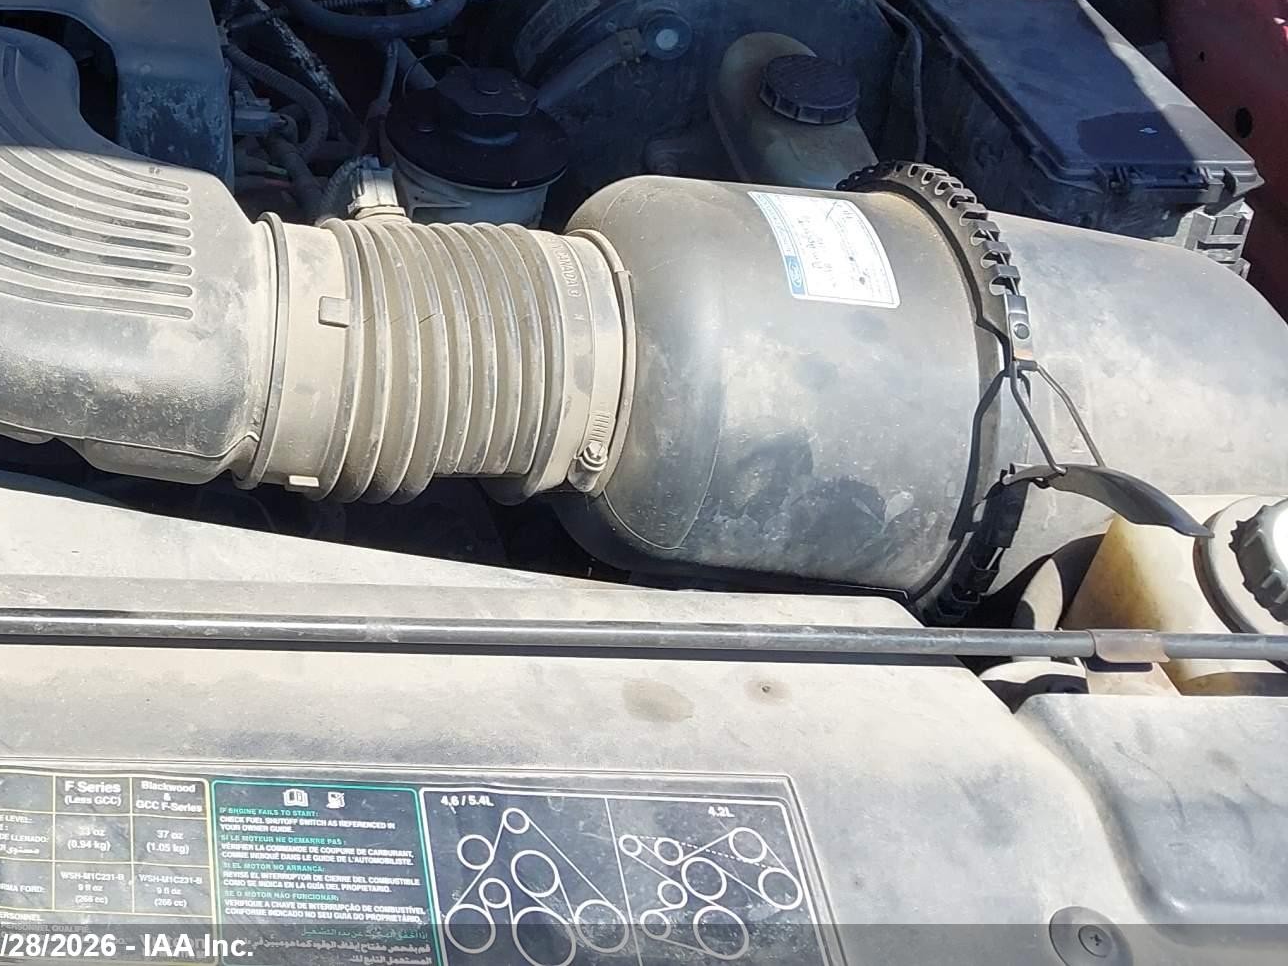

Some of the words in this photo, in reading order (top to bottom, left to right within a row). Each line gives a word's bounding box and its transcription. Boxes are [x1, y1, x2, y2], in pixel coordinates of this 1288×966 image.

[141, 781, 195, 793] Blackwood
[65, 795, 92, 805] (Less
[94, 794, 121, 806] GCC)
[163, 793, 171, 801] &
[441, 795, 459, 806] 4.6
[468, 794, 495, 806] 5.4L
[136, 800, 159, 809] GCC
[162, 802, 202, 812] F-Series
[708, 806, 735, 817] 4.2L
[299, 818, 326, 827] SWITCH
[339, 820, 386, 829] REFERENCED
[156, 830, 169, 839] 37
[171, 832, 184, 840] oz
[67, 840, 91, 850] (0.94
[93, 840, 111, 851] kg)
[146, 842, 170, 853] (1.05
[172, 844, 189, 855] kg)
[313, 874, 323, 882] DE
[368, 876, 421, 886] COMBUSTIBLE
[225, 899, 263, 908] VERIFIQUE
[268, 909, 303, 917] INDICADO
